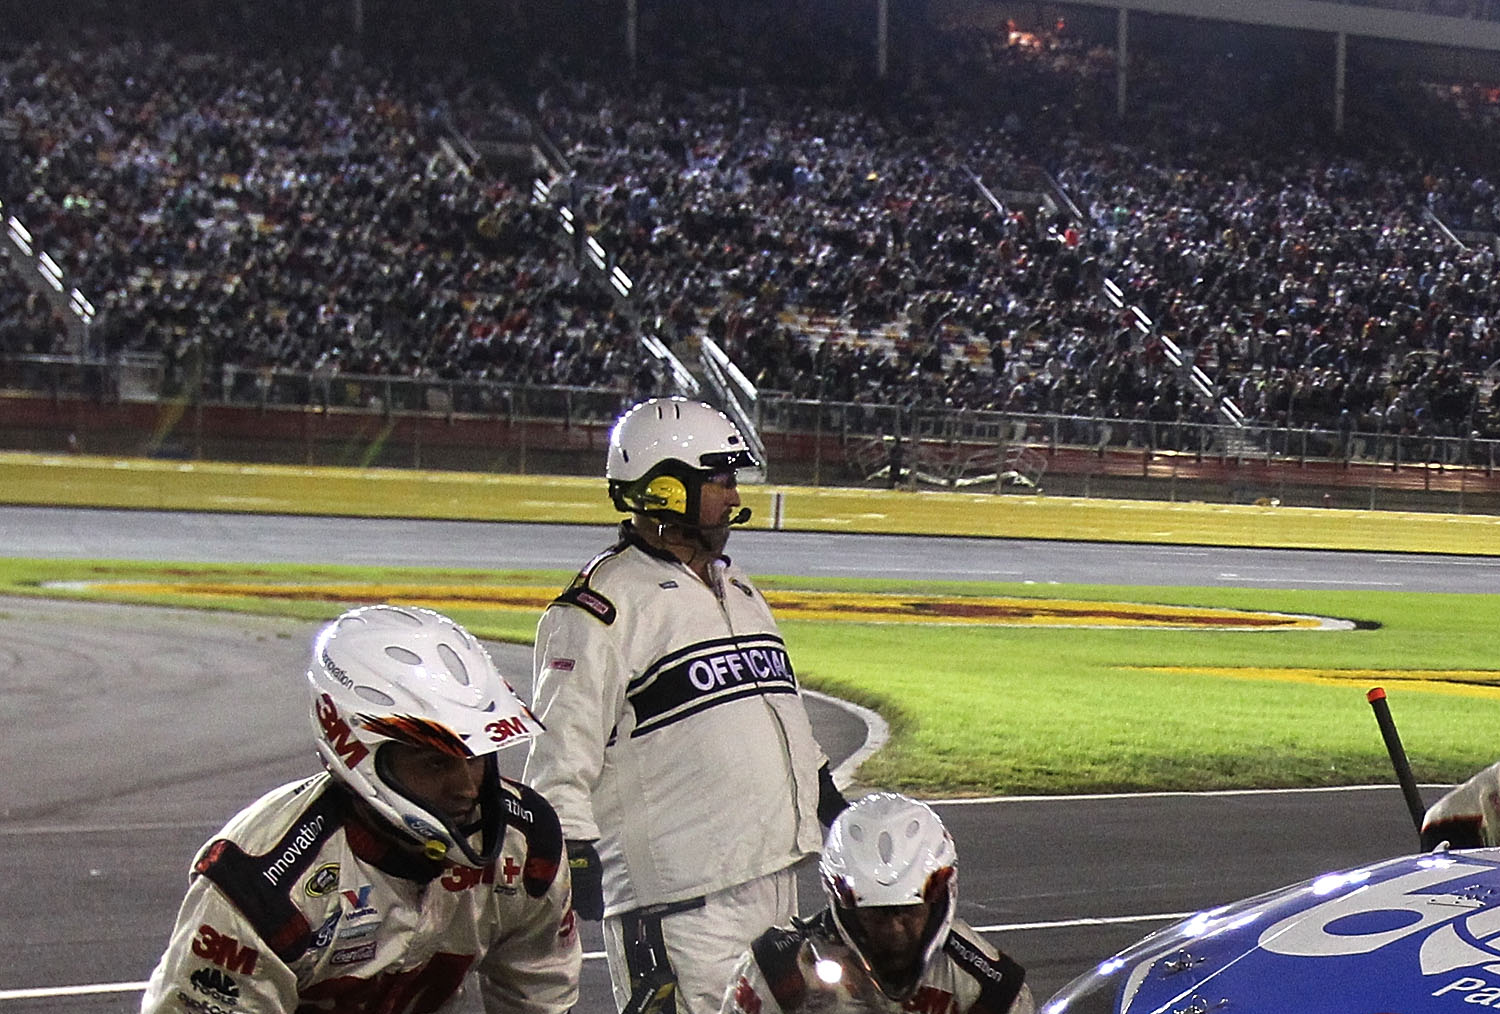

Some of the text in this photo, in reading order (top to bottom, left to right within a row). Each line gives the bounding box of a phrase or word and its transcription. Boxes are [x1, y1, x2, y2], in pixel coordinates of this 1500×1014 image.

[689, 650, 792, 691] OFFICIAL
[316, 693, 370, 771] 3M
[484, 716, 530, 743] 3M
[262, 813, 326, 887] Innovation
[192, 924, 259, 976] 3M
